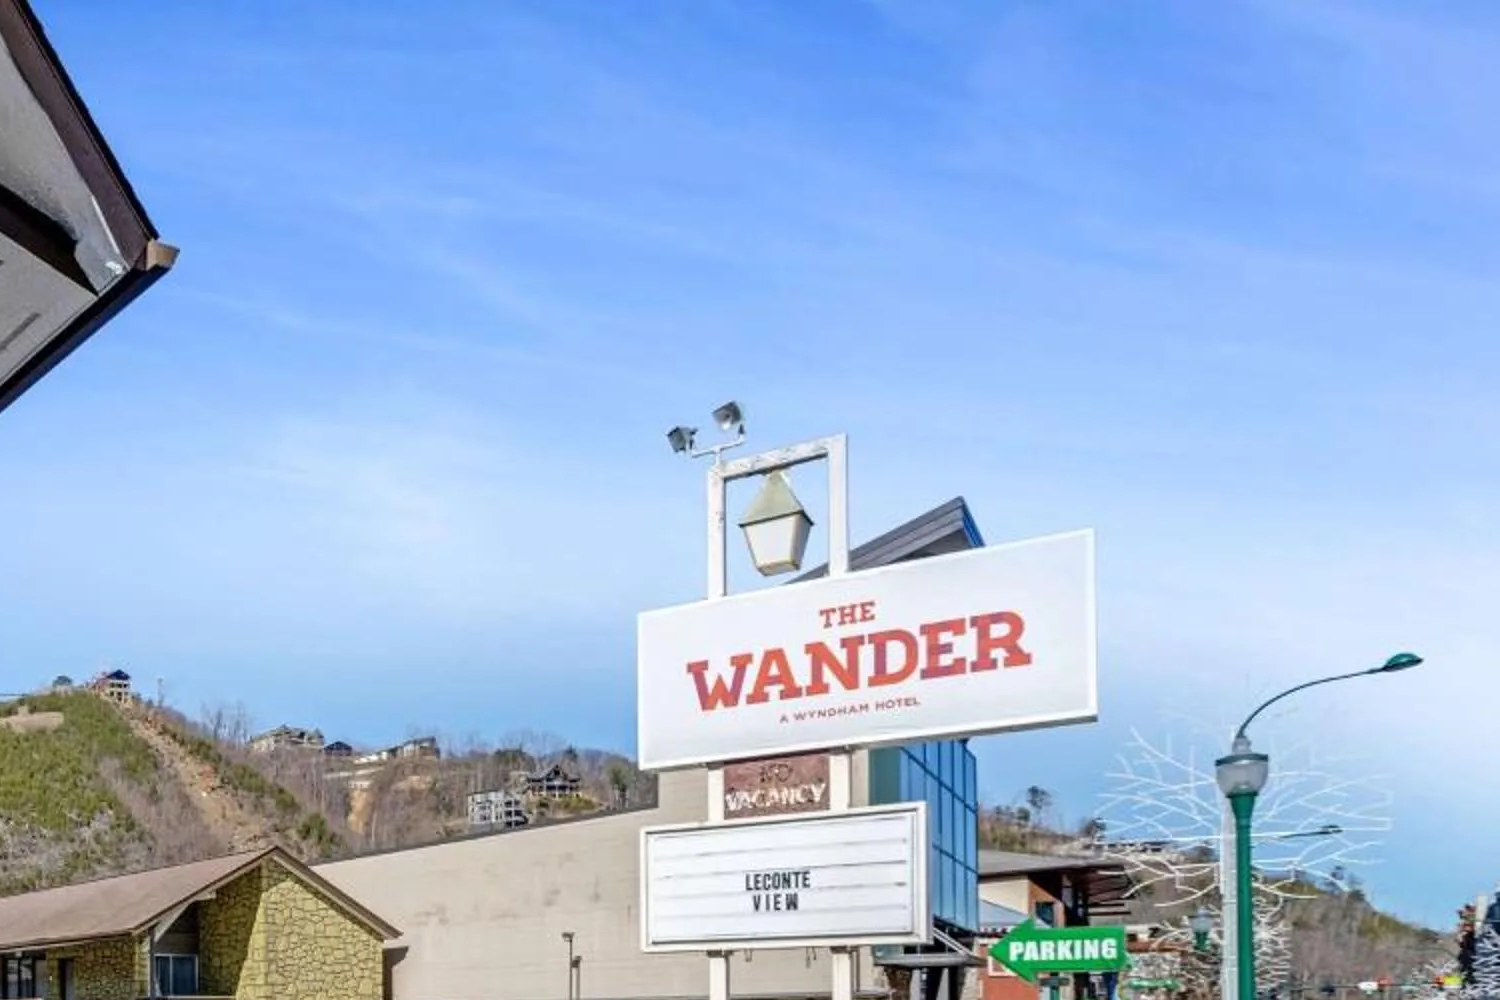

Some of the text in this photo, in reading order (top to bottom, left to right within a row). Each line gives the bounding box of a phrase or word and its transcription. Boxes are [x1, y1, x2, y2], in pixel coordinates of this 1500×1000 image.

[819, 601, 877, 629] THE
[687, 610, 1032, 711] WANDER
[779, 697, 921, 724] A WYNDHAM HOTEL
[725, 783, 827, 811] VACANCY
[745, 870, 811, 891] LECONTE
[753, 892, 799, 912] VIEW
[1009, 938, 1117, 961] PARKING
